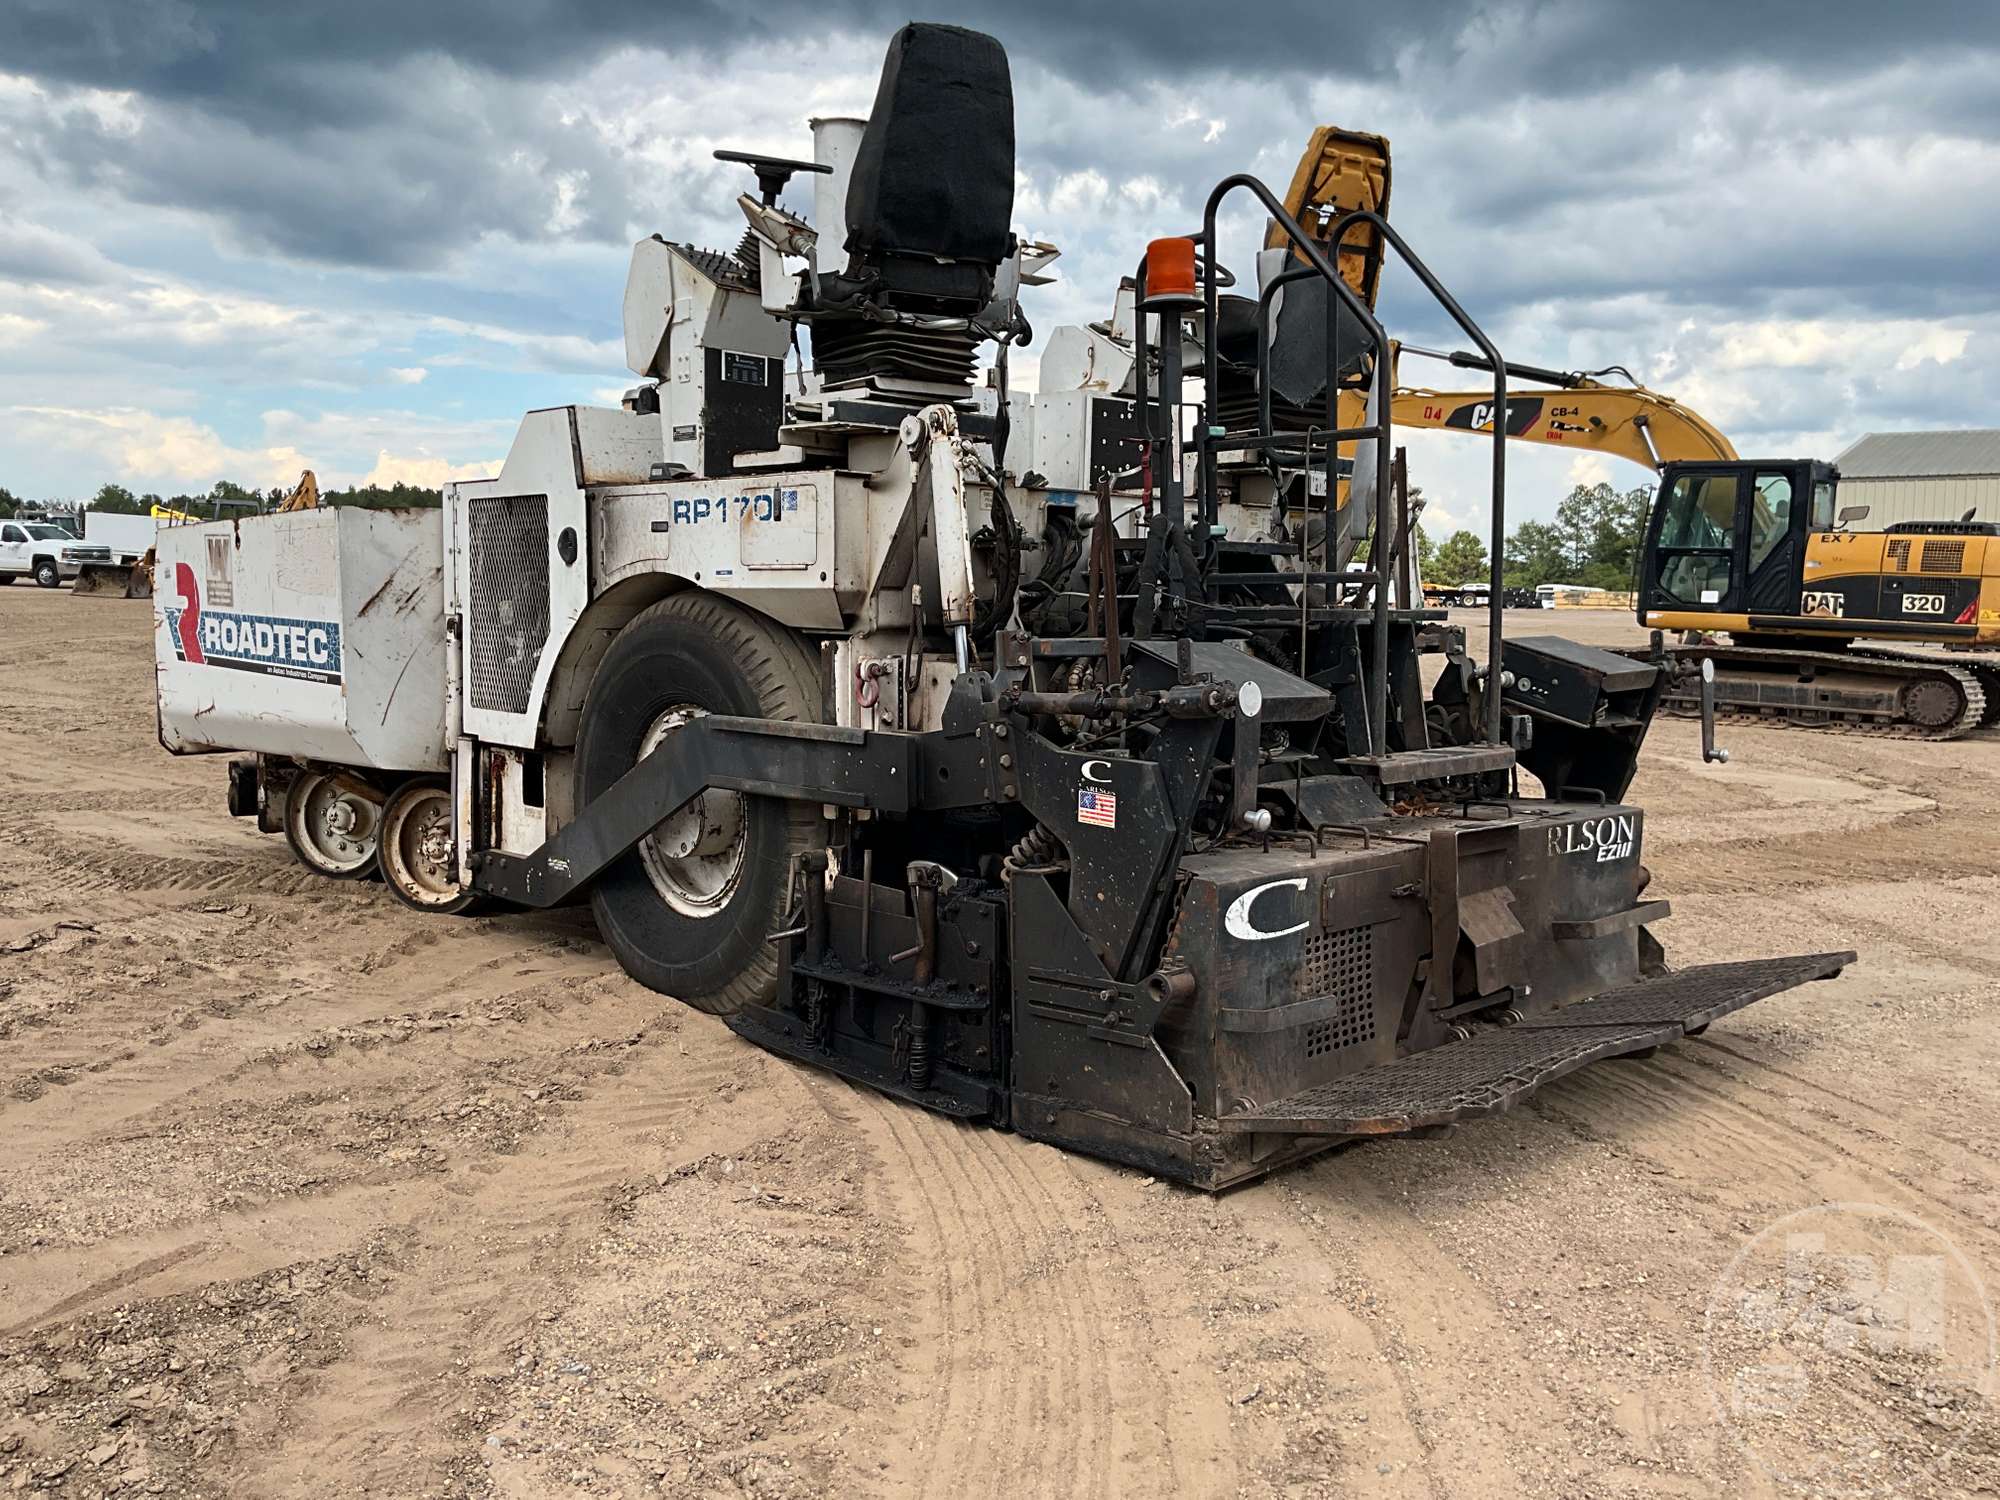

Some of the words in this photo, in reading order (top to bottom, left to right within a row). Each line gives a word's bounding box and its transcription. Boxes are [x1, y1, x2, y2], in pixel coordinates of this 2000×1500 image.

[1551, 407, 1579, 417] CB-4
[673, 494, 772, 524] RP170
[1821, 534, 1842, 543] EX
[1848, 535, 1857, 543] 7
[1802, 593, 1844, 614] CAT
[1904, 595, 1943, 612] 320
[205, 618, 328, 663] ROADTEC
[1225, 878, 1310, 940] C
